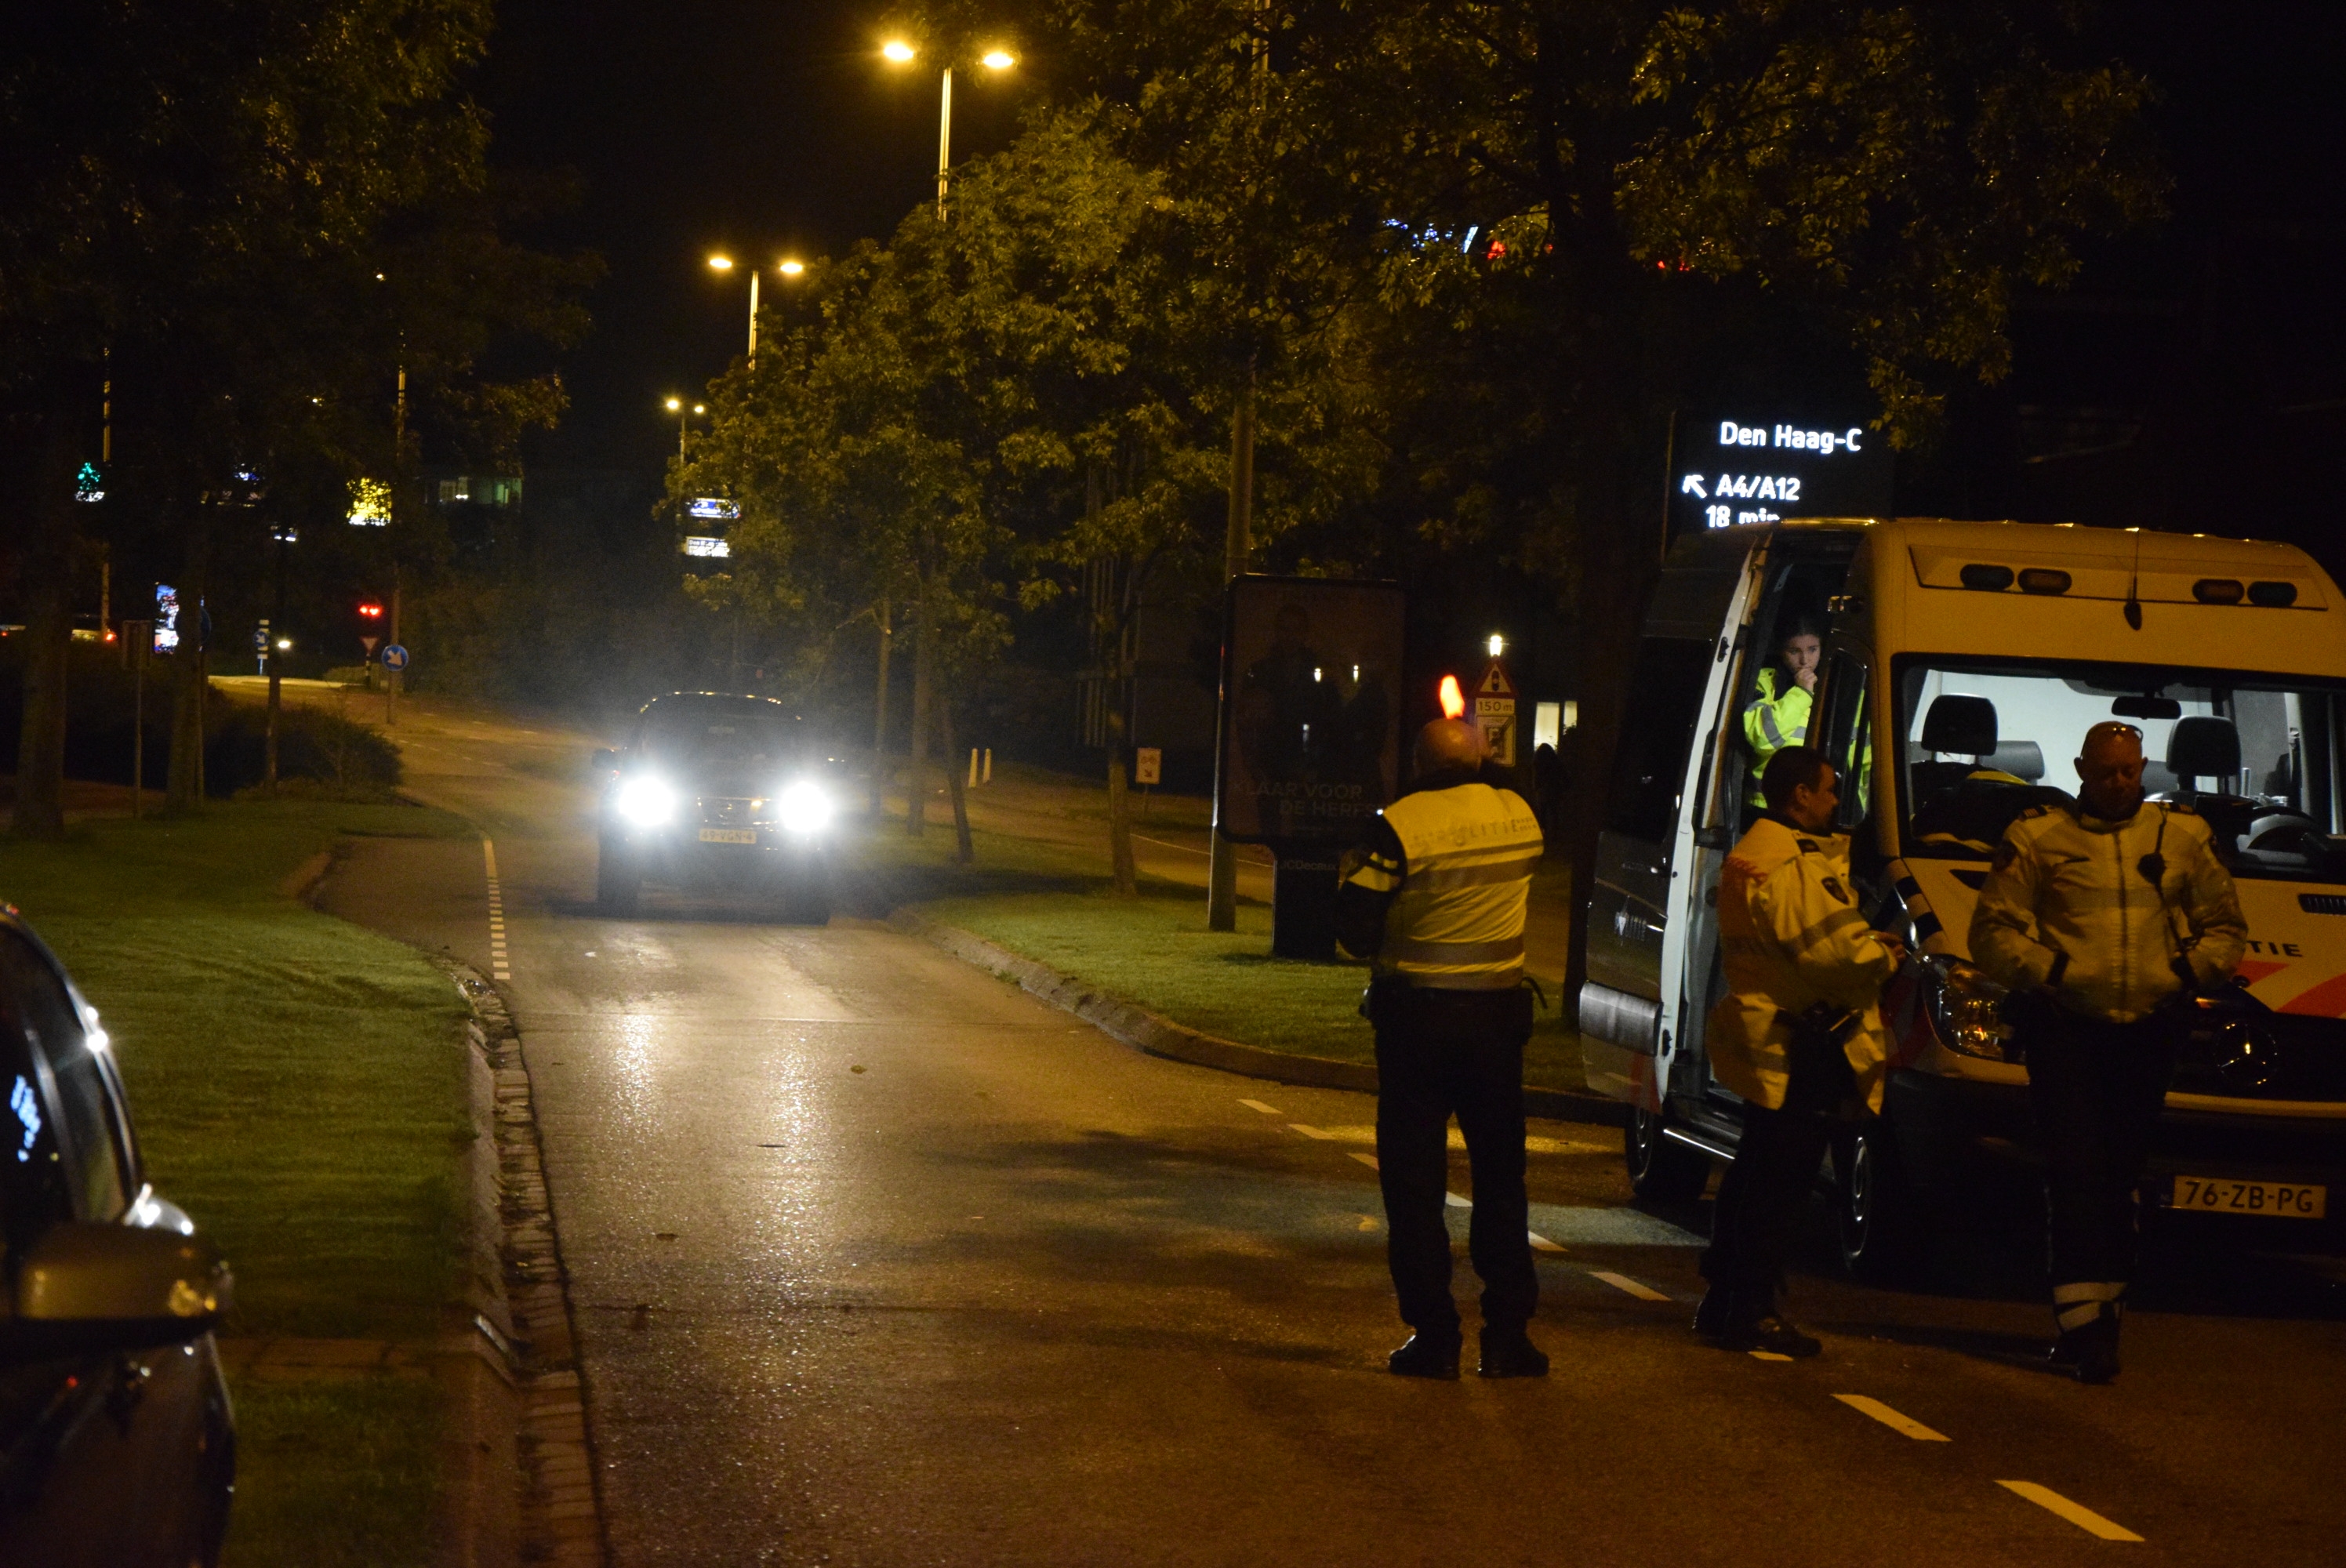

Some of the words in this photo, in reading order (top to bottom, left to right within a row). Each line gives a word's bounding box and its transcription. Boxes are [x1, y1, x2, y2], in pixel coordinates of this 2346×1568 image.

[1720, 421, 1766, 446] Den
[1774, 424, 1862, 454] Haag-C
[1716, 474, 1801, 501] A4/A12
[1705, 505, 1730, 528] 18
[1479, 701, 1502, 712] 150
[1303, 782, 1363, 800] VOOR
[1279, 798, 1306, 815] DE
[1312, 800, 1378, 818] HERFS
[2185, 1181, 2313, 1213] 76-ZB-PG
